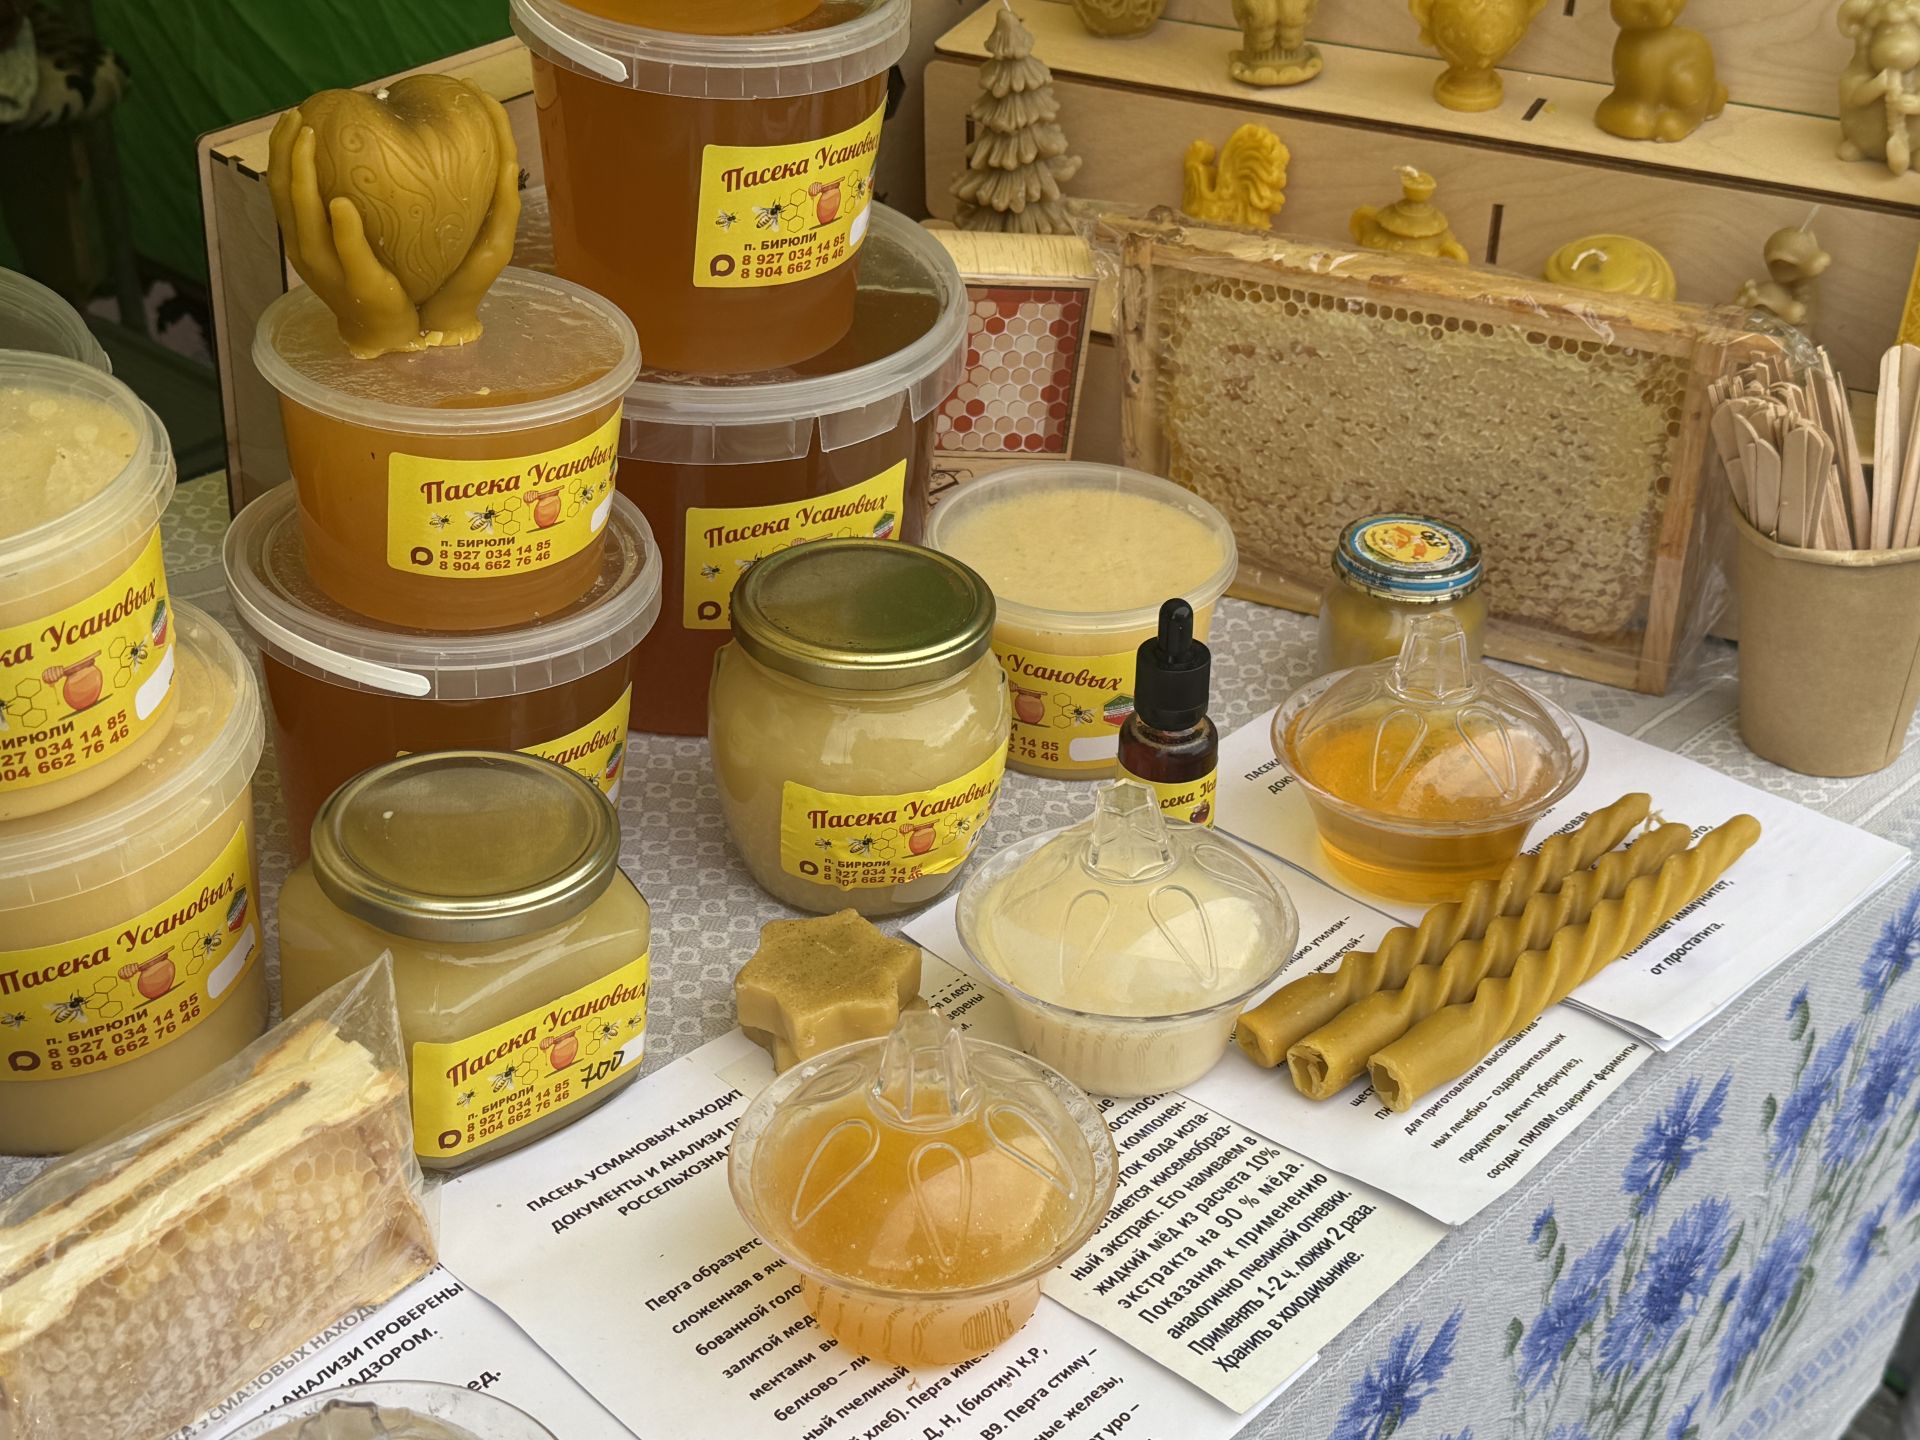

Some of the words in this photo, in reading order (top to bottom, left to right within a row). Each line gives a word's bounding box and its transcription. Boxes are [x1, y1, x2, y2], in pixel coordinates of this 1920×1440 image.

[721, 158, 810, 192] Пасека
[740, 268, 749, 278] 8
[755, 265, 783, 278] 904
[787, 260, 811, 274] 662
[815, 254, 828, 267] 76
[832, 246, 844, 260] 46
[741, 255, 751, 265] 8
[756, 252, 784, 264] 927
[788, 246, 813, 261] 034
[817, 239, 831, 252] 14
[833, 233, 845, 246] 85
[760, 232, 817, 250] БИРЮЛИ
[420, 474, 521, 504] Пасека
[527, 444, 614, 486] Усановых
[456, 537, 516, 548] БИРЮЛИ
[704, 517, 790, 548] Пасека
[796, 494, 888, 527] Усановых
[439, 550, 448, 560] 8
[453, 550, 480, 560] 927
[485, 548, 511, 560] 034
[517, 545, 532, 555] 14
[536, 540, 551, 551] 85
[439, 561, 448, 571] 8
[452, 561, 480, 571] 904
[485, 559, 511, 570] 662
[516, 556, 531, 567] 76
[535, 551, 550, 562] 46
[40, 578, 156, 652] Усановых
[1007, 653, 1123, 691] Усановых
[0, 721, 74, 750] ИРЮЛИ
[35, 737, 74, 759] 034
[80, 725, 102, 743] 14
[107, 709, 127, 730] 85
[37, 754, 76, 773] 662
[81, 739, 104, 759] 76
[109, 725, 129, 745] 46
[1019, 747, 1036, 759] 76
[1040, 750, 1059, 762] 46
[1020, 736, 1038, 748] 14
[1040, 739, 1059, 751] 85
[807, 809, 897, 829] Пасека
[903, 778, 995, 820] Усановых
[837, 860, 891, 868] БИРЮЛИ
[862, 867, 886, 875] 034
[891, 867, 906, 875] 14
[0, 945, 111, 995] Пасека
[117, 872, 235, 952] Усановых
[1310, 920, 1346, 948] утилизи
[1650, 963, 1667, 976] от
[1664, 921, 1726, 965] простатита.
[951, 981, 977, 999] лесу.
[46, 1038, 62, 1046] п.
[68, 1008, 149, 1041] БИРЮЛИ
[48, 1049, 60, 1059] 8
[67, 1038, 103, 1056] 927
[111, 1025, 147, 1045] 034
[153, 1008, 174, 1026] 14
[179, 993, 199, 1012] 85
[51, 1060, 63, 1071] 8
[70, 1050, 108, 1068] 904
[114, 1037, 150, 1057] 662
[155, 1021, 176, 1039] 76
[181, 1006, 200, 1024] 46
[446, 1026, 537, 1088] Пасека
[543, 979, 647, 1032] Усановых
[1421, 1064, 1487, 1121] приготовления
[1483, 1021, 1538, 1068] высокоактив
[1430, 1132, 1452, 1149] ных
[1449, 1100, 1488, 1136] лечебно
[1492, 1032, 1567, 1097] оздоровительных
[467, 1123, 475, 1133] 8
[480, 1110, 503, 1130] 927
[508, 1098, 531, 1116] 034
[536, 1088, 551, 1101] 14
[555, 1079, 570, 1093] 85
[467, 1133, 475, 1143] 8
[479, 1121, 504, 1140] 904
[508, 1108, 532, 1126] 662
[536, 1099, 551, 1112] 76
[554, 1090, 570, 1103] 46
[468, 1113, 479, 1121] п.
[482, 1085, 534, 1116] БИРЮЛИ
[1119, 1100, 1187, 1151] компонен-
[1458, 1123, 1508, 1165] продуктов.
[1504, 1096, 1538, 1123] Лечит
[1531, 1058, 1584, 1101] туберкулез,
[1486, 1144, 1525, 1180] сосуды.
[1518, 1113, 1558, 1148] ПЖЛВМ
[1555, 1079, 1599, 1116] содержит
[1595, 1042, 1640, 1082] ферменты
[526, 1177, 588, 1212] ПАСЕКА
[584, 1124, 681, 1181] УСМАНОВЫХ
[679, 1088, 744, 1130] НАХОДИТ
[1141, 1136, 1179, 1163] вода
[1173, 1110, 1209, 1140] испа-
[1150, 1124, 1232, 1188] киселеобраз-
[551, 1174, 647, 1235] ДОКУМЕНТЫ
[644, 1166, 661, 1179] И
[660, 1127, 728, 1171] АНАЛИЗИ
[1070, 1252, 1105, 1282] ный
[1100, 1209, 1165, 1257] экстракт.
[1156, 1189, 1187, 1209] Его
[1184, 1141, 1247, 1192] наливаем
[1243, 1135, 1258, 1146] в
[1092, 1248, 1152, 1296] жидкий
[1147, 1226, 1184, 1252] мёд
[1176, 1211, 1199, 1229] из
[1195, 1171, 1251, 1215] расчета
[1245, 1147, 1281, 1172] 10%
[1117, 1245, 1198, 1309] экстракта
[1195, 1228, 1221, 1247] на
[1215, 1207, 1243, 1228] 90
[1238, 1194, 1260, 1209] %
[1258, 1162, 1304, 1196] мёда.
[1138, 1257, 1227, 1324] Показания
[1224, 1247, 1239, 1259] к
[1235, 1173, 1328, 1249] применению
[1166, 1277, 1244, 1340] аналогично
[1238, 1228, 1301, 1281] пчелиной
[1296, 1189, 1353, 1233] огневки.
[1187, 1298, 1265, 1356] Применять
[1257, 1276, 1289, 1300] 1-2
[1280, 1268, 1300, 1280] ч.
[1294, 1237, 1336, 1272] ложки
[1326, 1226, 1346, 1241] 2
[1339, 1203, 1377, 1234] раза.
[362, 1282, 465, 1351] ПРОВЕРЕНЫ
[644, 1280, 692, 1312] Перга
[671, 1278, 754, 1335] сложенная
[752, 1270, 765, 1282] в
[1211, 1327, 1273, 1373] Хранить
[1267, 1318, 1283, 1331] в
[1276, 1250, 1365, 1324] холодильнике.
[695, 1303, 770, 1357] бованной
[722, 1333, 784, 1380] залитой
[749, 1351, 817, 1402] ментами
[773, 1375, 839, 1423] белково
[834, 1365, 911, 1419] пчелиный
[956, 1365, 1022, 1417] (биотин)
[1003, 1387, 1050, 1423] Перга
[1047, 1354, 1091, 1390] стиму
[1063, 1376, 1125, 1422] железы,
[863, 1408, 910, 1440] хлеб).
[905, 1376, 952, 1410] Перга
[1102, 1411, 1132, 1437] уро
